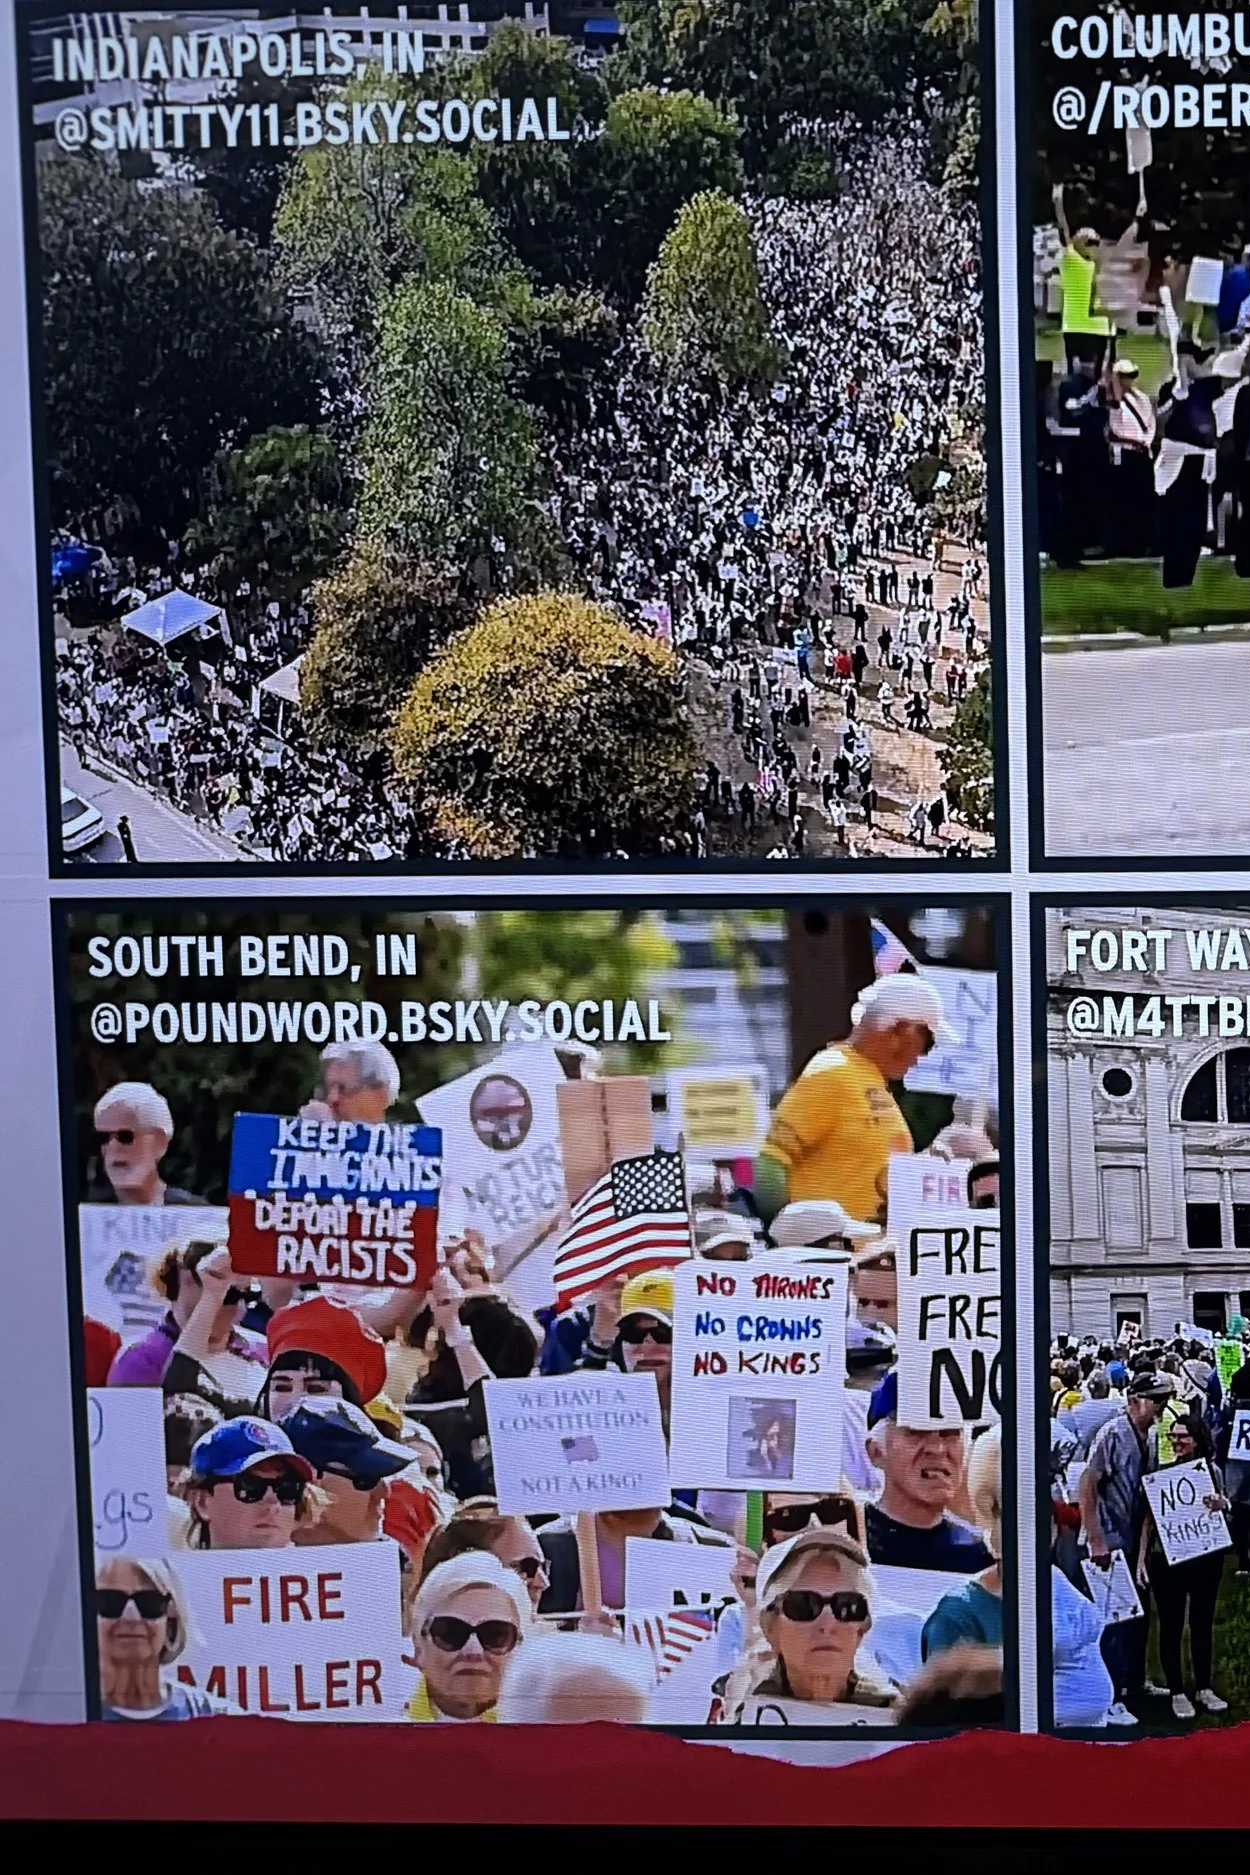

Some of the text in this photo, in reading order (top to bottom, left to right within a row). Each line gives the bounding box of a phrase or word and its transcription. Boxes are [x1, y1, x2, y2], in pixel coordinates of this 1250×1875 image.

[52, 29, 425, 81] INDIANAPOLIS, IN
[55, 97, 571, 152] @SMITTY11.BSKY.SOCIAL
[88, 933, 417, 983] SOUTH BEND, IN
[1066, 929, 1172, 972] FORT
[91, 1000, 671, 1045] @POUNDWORD.BSKY.SOCIAL
[277, 1118, 418, 1157] KEEP THE
[922, 1174, 962, 1202] FIR
[277, 1235, 417, 1285] RACISTS
[696, 1272, 834, 1300] NO THRONES
[695, 1311, 823, 1341] NO CROWNS
[693, 1350, 821, 1376] NO KINGS
[1161, 1477, 1196, 1516] NO
[222, 1572, 346, 1625] FIRE
[177, 1659, 383, 1713] MILLER
